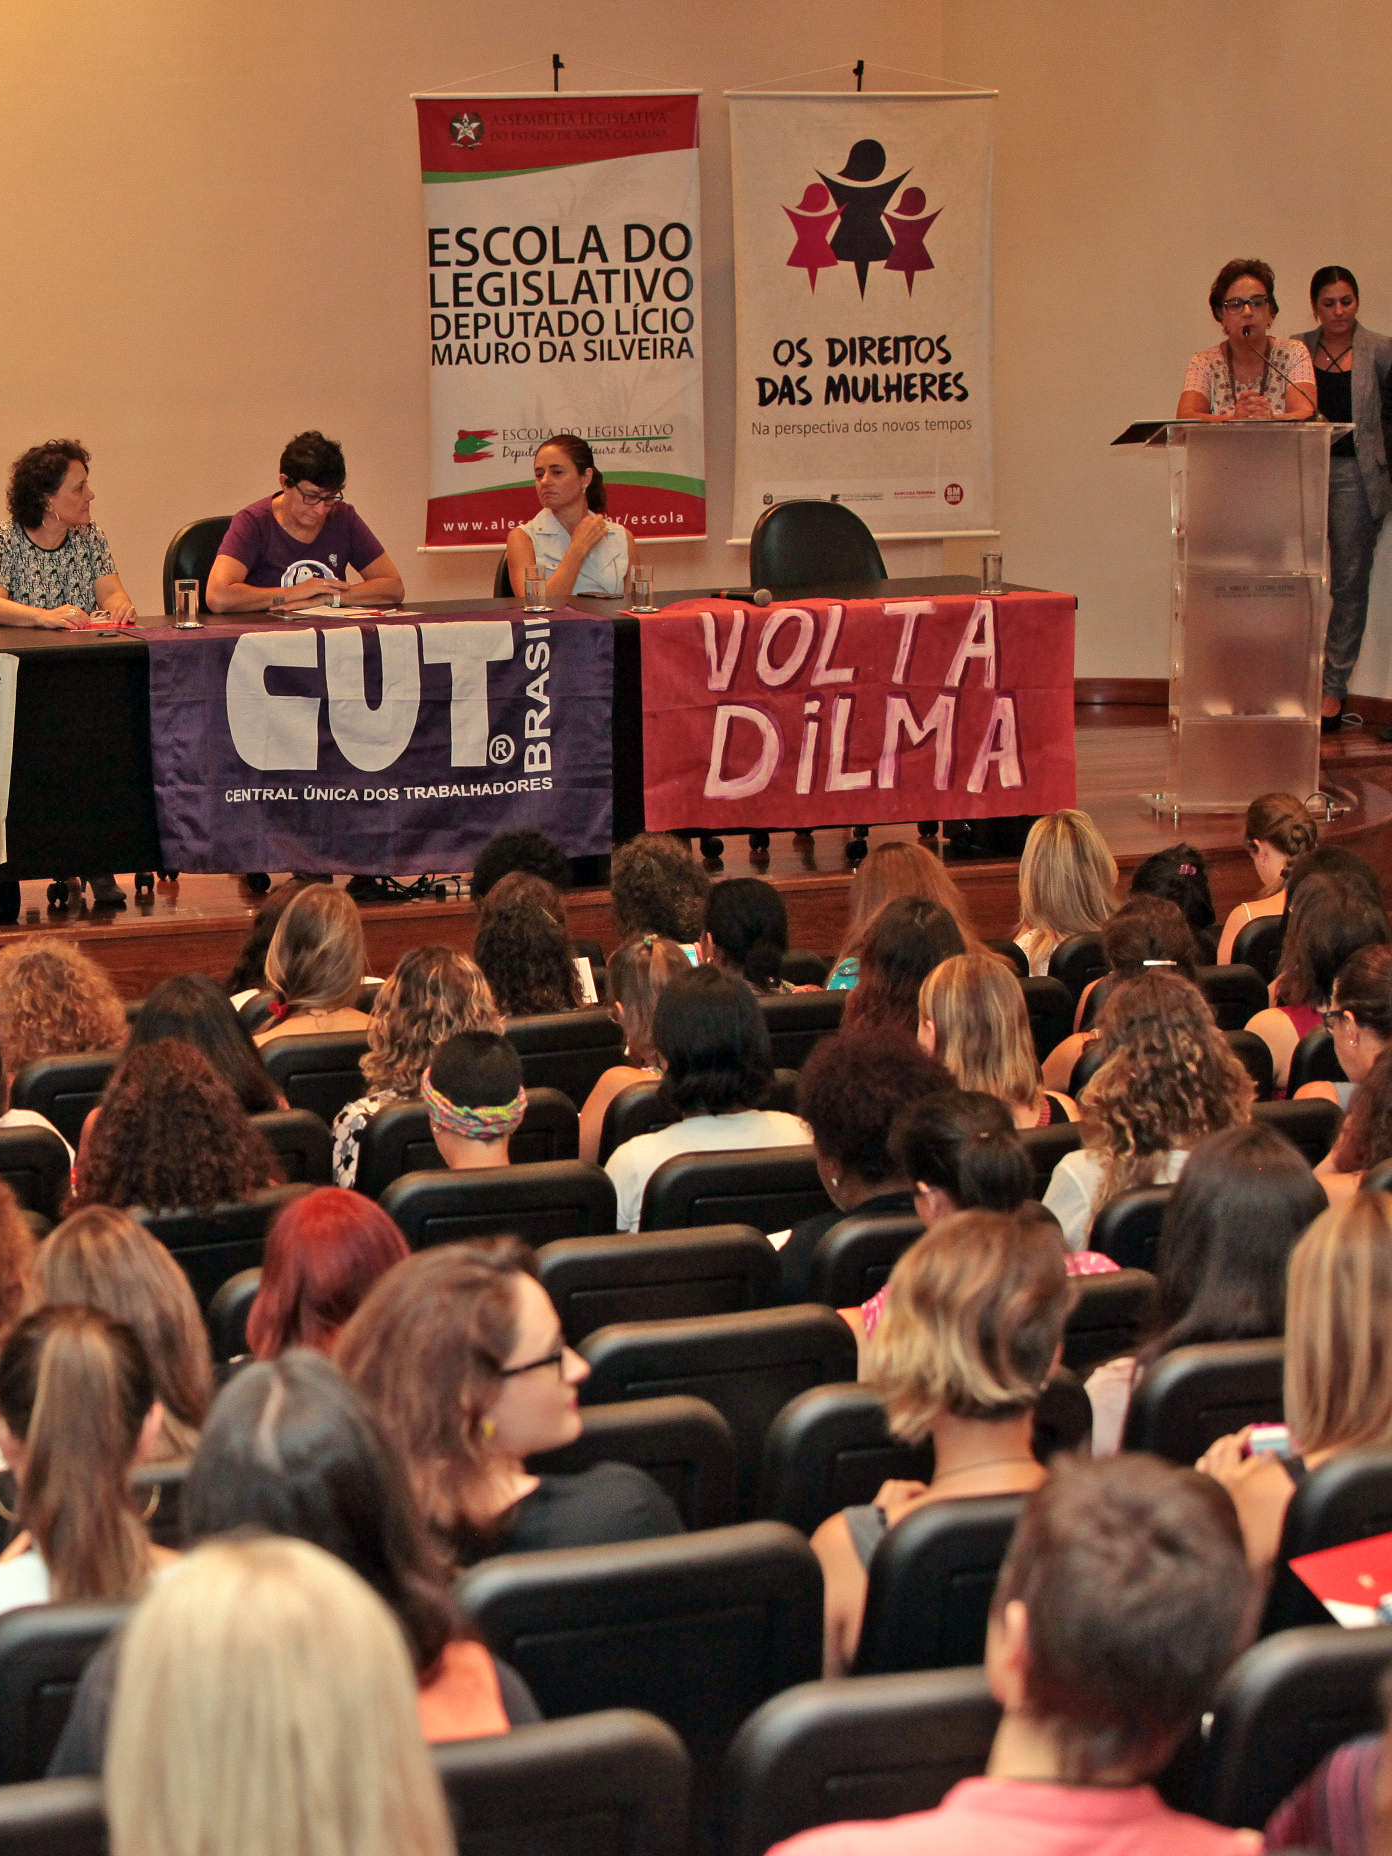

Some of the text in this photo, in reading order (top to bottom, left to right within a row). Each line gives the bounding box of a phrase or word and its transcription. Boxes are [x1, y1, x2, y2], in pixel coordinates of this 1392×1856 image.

[579, 110, 668, 125] LEGISLATIVA
[428, 222, 693, 267] ESCOLA DO
[429, 266, 695, 308] LEGISLATIVO
[430, 303, 695, 340] DEPUTADO LÍCIO
[431, 336, 695, 366] MAURO DA SILVEIRA
[773, 334, 952, 368] OS DIREITOS
[755, 371, 969, 407] DAS MULHERES
[502, 428, 554, 441] ESCOLA
[587, 423, 674, 438] LEGISLATIVO
[752, 418, 972, 438] Na perspectiva dos novos tempos
[590, 446, 615, 455] auro
[619, 441, 632, 454] da
[635, 439, 675, 454] Silveira
[699, 599, 1001, 692] VOLTA
[226, 620, 514, 772] CUT
[225, 777, 553, 803] CENTRAL ÚNICA DOS TRABALHADORES
